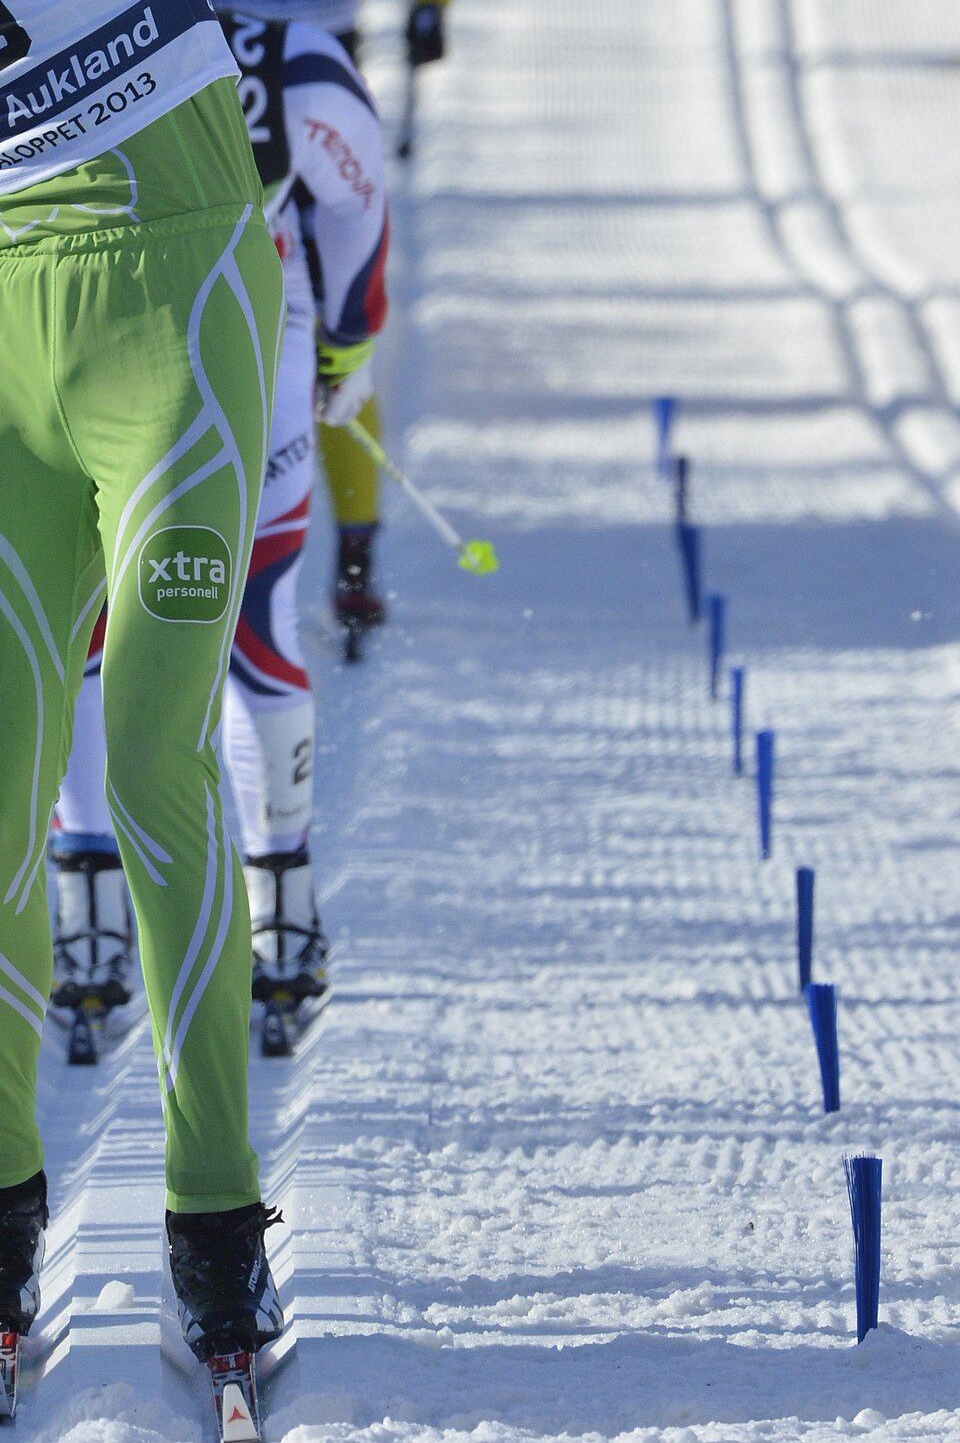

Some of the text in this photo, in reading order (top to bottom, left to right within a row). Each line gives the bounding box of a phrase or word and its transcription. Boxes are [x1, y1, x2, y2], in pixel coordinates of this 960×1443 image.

[7, 6, 161, 127] Aukland
[87, 71, 158, 126] 2013
[148, 550, 226, 585] xtra
[156, 585, 219, 601] personell
